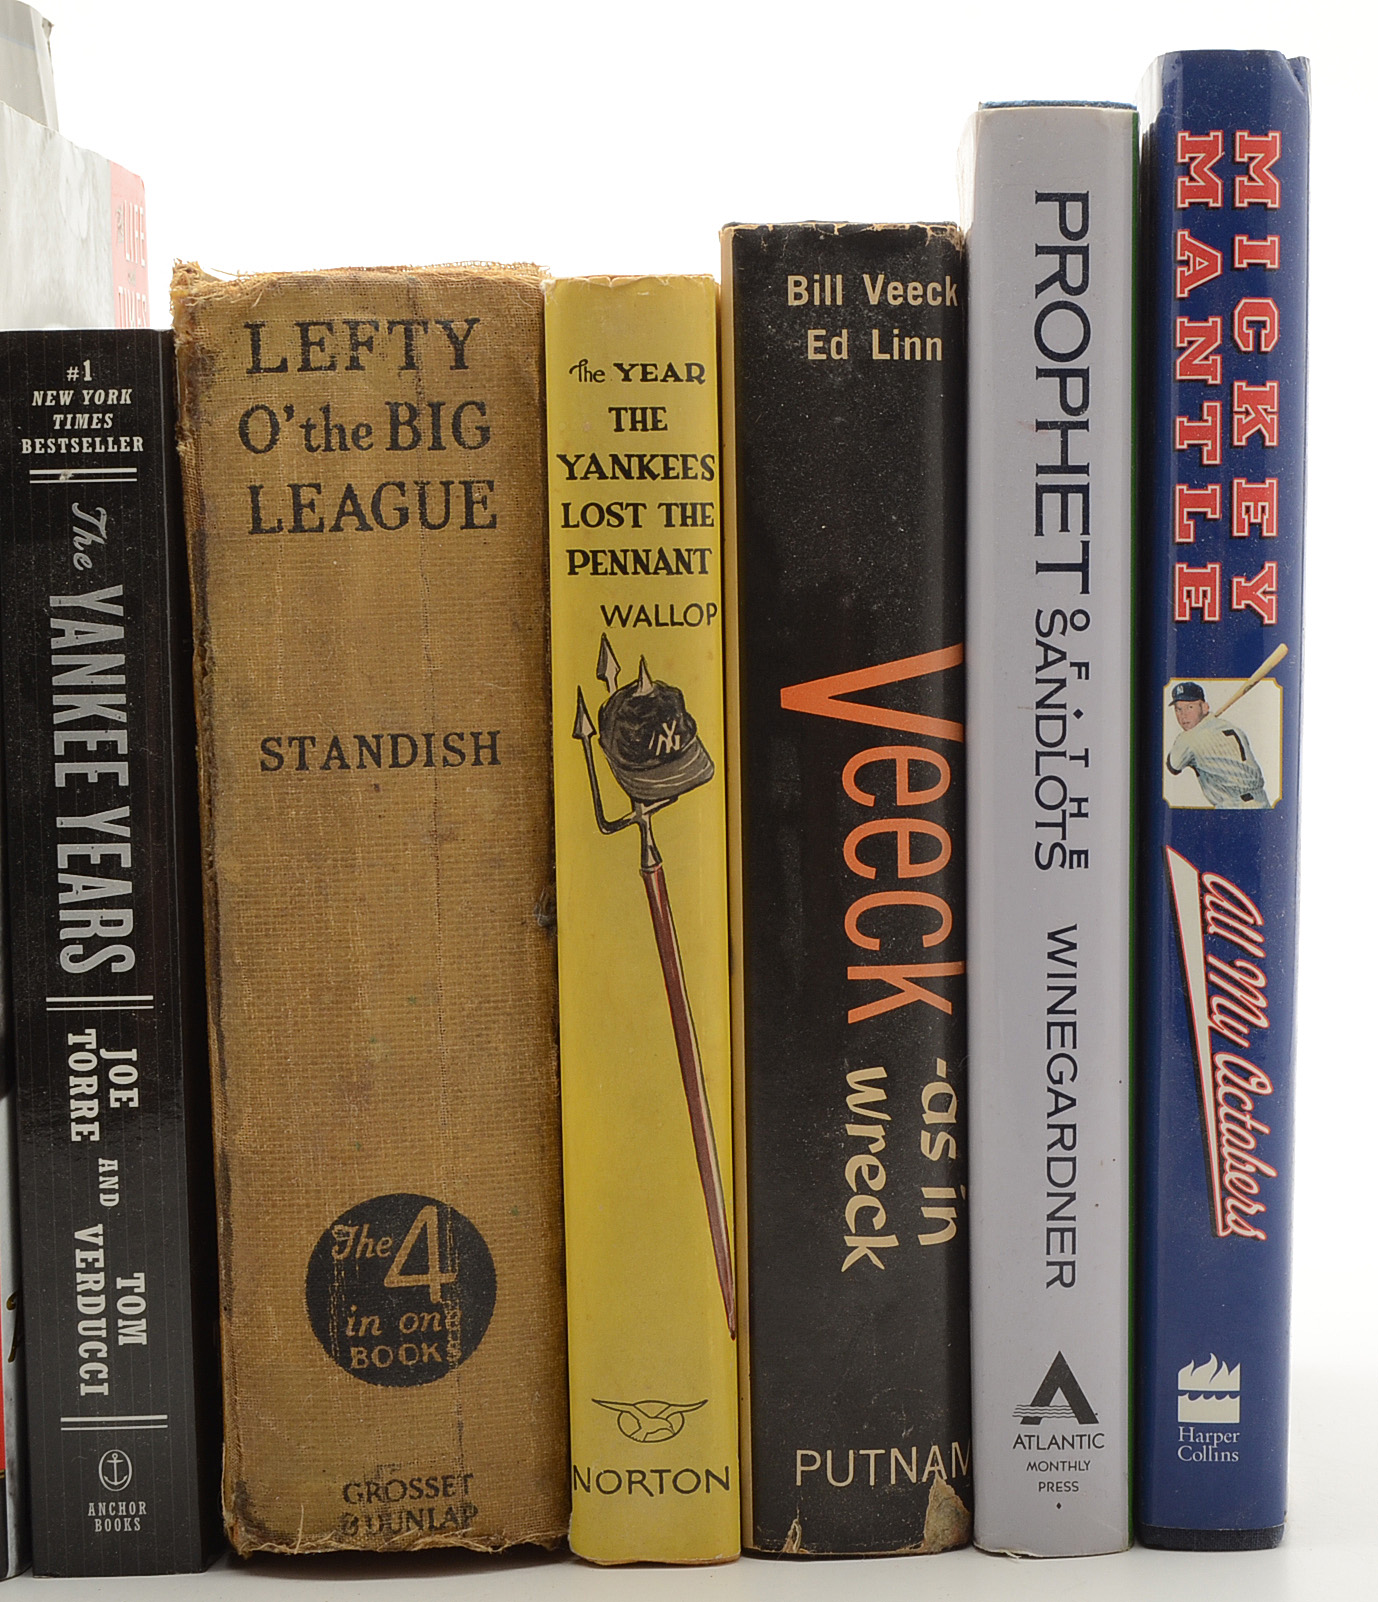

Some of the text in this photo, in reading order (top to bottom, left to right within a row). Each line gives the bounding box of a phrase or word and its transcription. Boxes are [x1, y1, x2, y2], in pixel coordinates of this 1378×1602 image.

[123, 199, 146, 266] LIFE
[786, 273, 959, 306] Bill Veeck
[243, 317, 481, 376] LEFTY
[806, 328, 944, 361] Ed Linn
[65, 358, 93, 383] #1
[568, 358, 706, 384] The YEAR
[1173, 130, 1224, 622] MANTLE
[1232, 130, 1281, 625] MICKEY
[31, 387, 133, 407] NEW YORK
[1034, 190, 1092, 595] PROPHET
[52, 413, 115, 431] TIMES
[384, 400, 492, 453] BIG
[608, 406, 668, 433] THE
[20, 436, 145, 455] BESTSELLER
[556, 453, 716, 482] YANKEES
[247, 479, 498, 535] LEAGUE
[560, 501, 715, 529] LOST THE
[71, 501, 107, 572] The
[566, 548, 713, 576] PENNANT
[600, 602, 718, 628] WALLOP
[259, 729, 501, 773] STANDISH
[1034, 608, 1068, 871] SANDLOTS
[1222, 728, 1247, 763] 7
[48, 584, 137, 974] YANKEE YEARS
[780, 642, 965, 1024] Veeck
[1202, 871, 1266, 958] All
[66, 1027, 101, 1144] TORRE
[99, 1046, 140, 1109] JOE
[1046, 923, 1078, 1290] WINEGARDNER
[97, 1156, 121, 1209] AND
[917, 1184, 967, 1246] in
[330, 1205, 457, 1303] The 4
[73, 1223, 110, 1397] VERDUCCI
[115, 1271, 148, 1347] TOM
[345, 1304, 383, 1337] in
[1012, 1432, 1105, 1451] ATLANTIC
[1178, 1425, 1240, 1448] Harper
[1178, 1443, 1240, 1462] Collins
[572, 1463, 731, 1498] NORTON
[1026, 1460, 1091, 1472] MONTHLY
[342, 1472, 474, 1504] GROSSET
[1038, 1481, 1079, 1493] PRESS
[87, 1501, 148, 1517] ANCHOR
[93, 1517, 142, 1534] BOOKS
